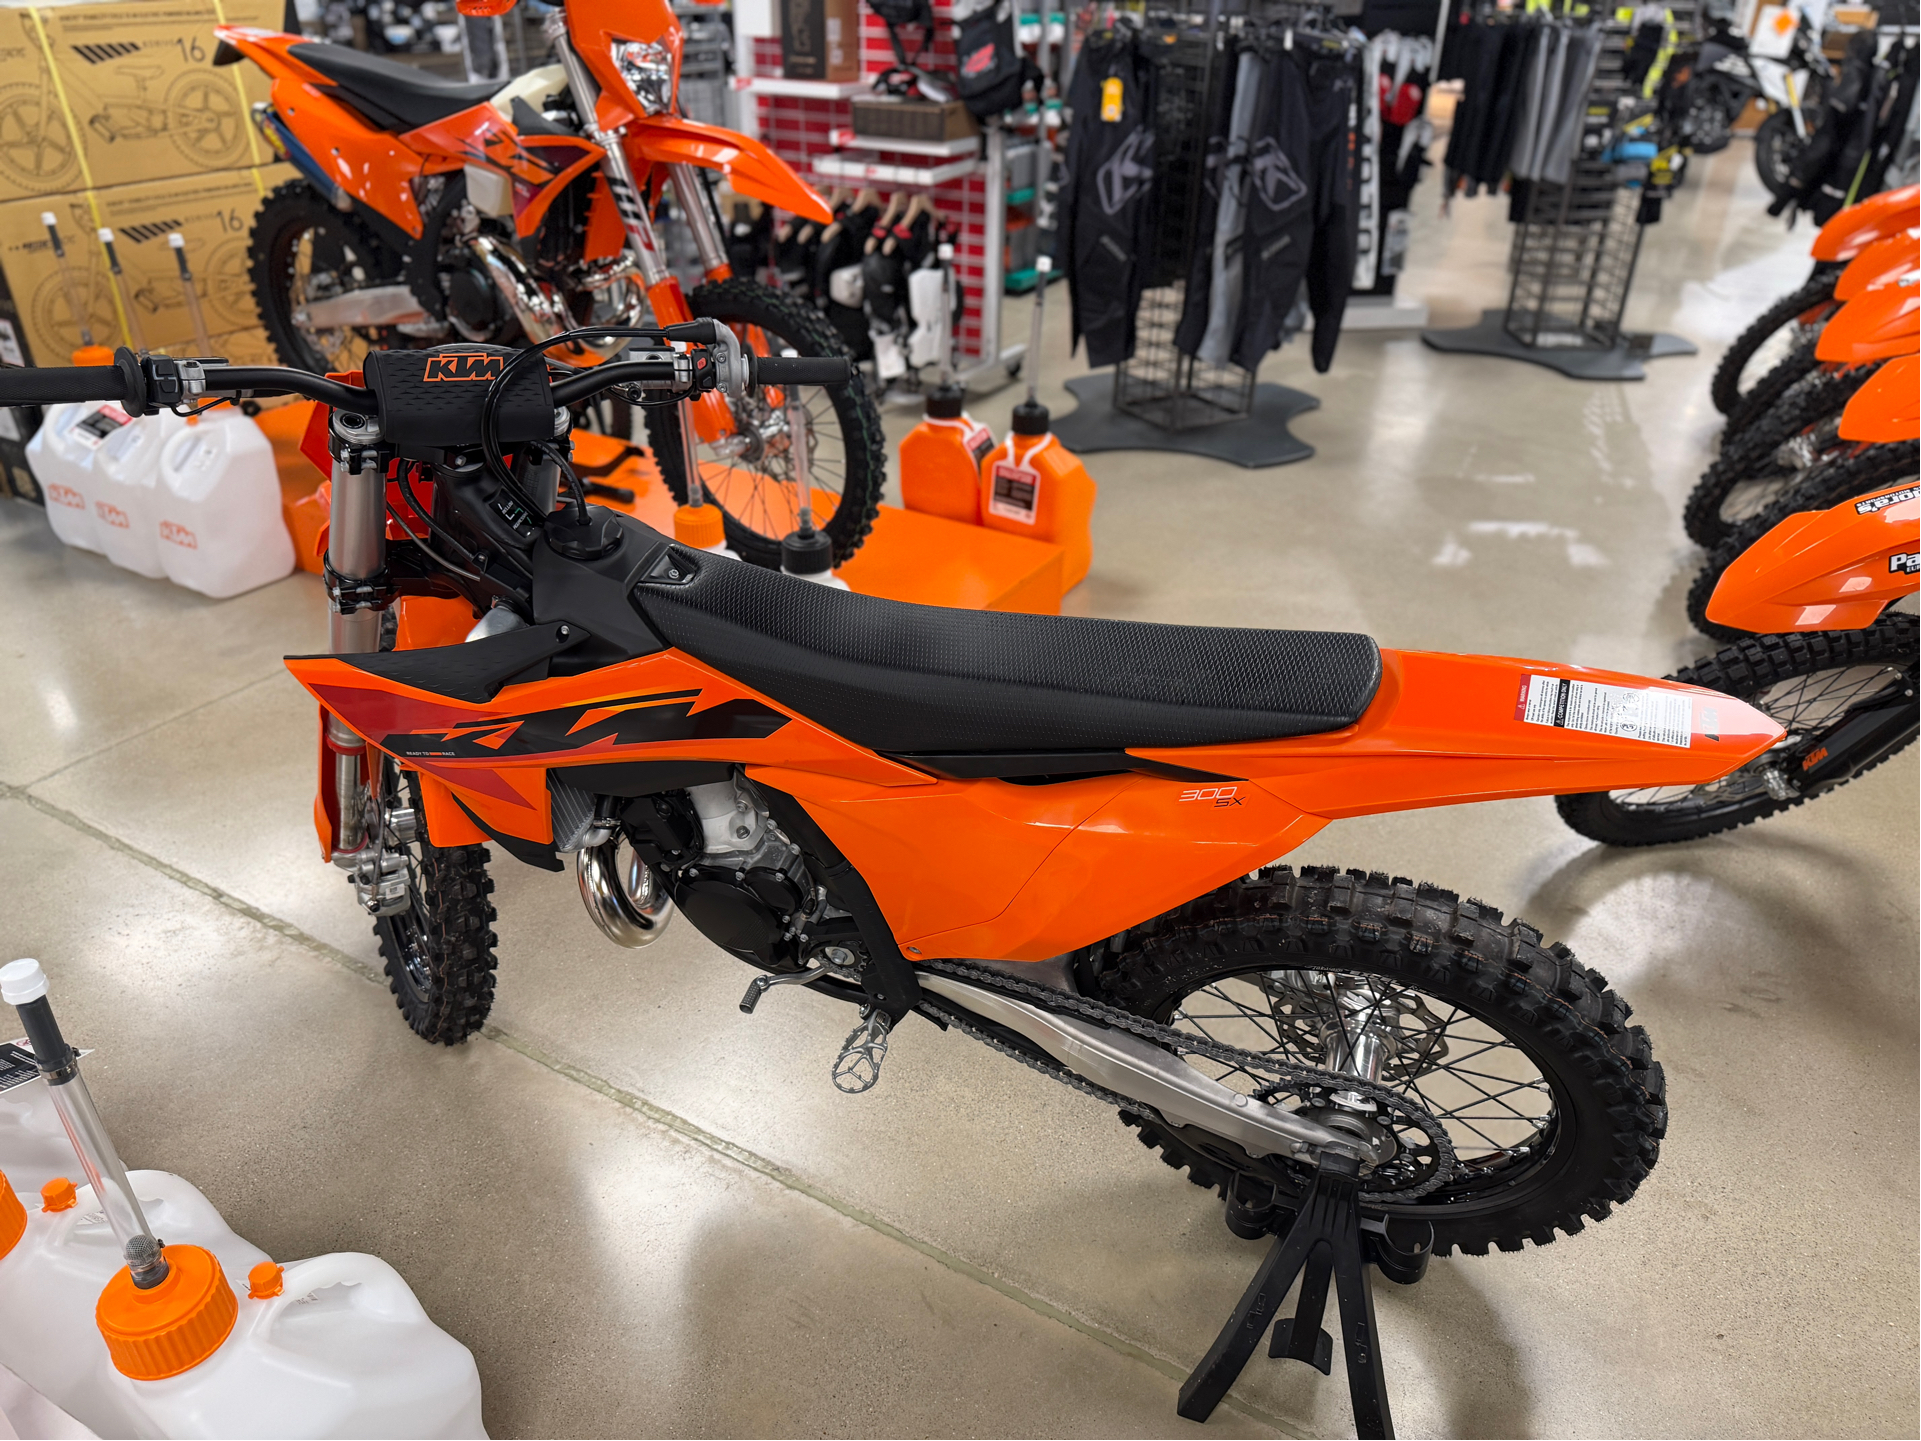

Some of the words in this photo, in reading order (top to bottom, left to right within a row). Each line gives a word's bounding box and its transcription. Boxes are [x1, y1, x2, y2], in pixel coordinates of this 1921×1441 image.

[176, 36, 206, 63] 16
[216, 207, 244, 234] 16
[423, 353, 504, 382] KTM
[159, 519, 198, 551] KTM
[1802, 747, 1829, 771] KTM
[1179, 786, 1238, 802] 300
[1214, 796, 1246, 808] SX
